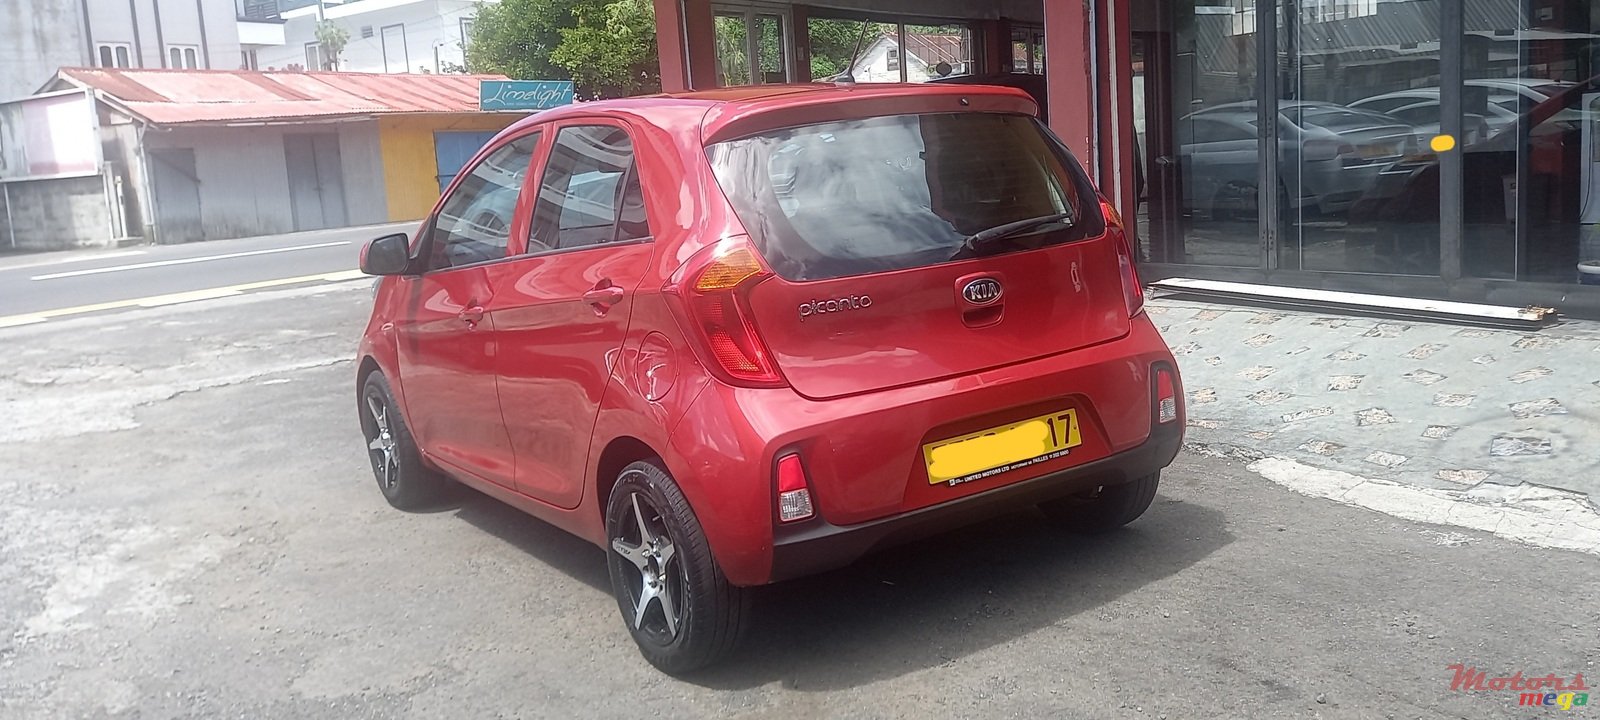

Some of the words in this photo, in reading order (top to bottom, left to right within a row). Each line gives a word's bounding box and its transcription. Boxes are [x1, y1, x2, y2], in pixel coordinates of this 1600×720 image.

[483, 82, 572, 108] Limelight
[969, 282, 999, 300] KIA
[799, 294, 872, 322] picanto
[1047, 413, 1071, 447] 17
[964, 473, 982, 483] UNITED
[982, 468, 1001, 478] MOTORS
[1001, 465, 1010, 473] LTD
